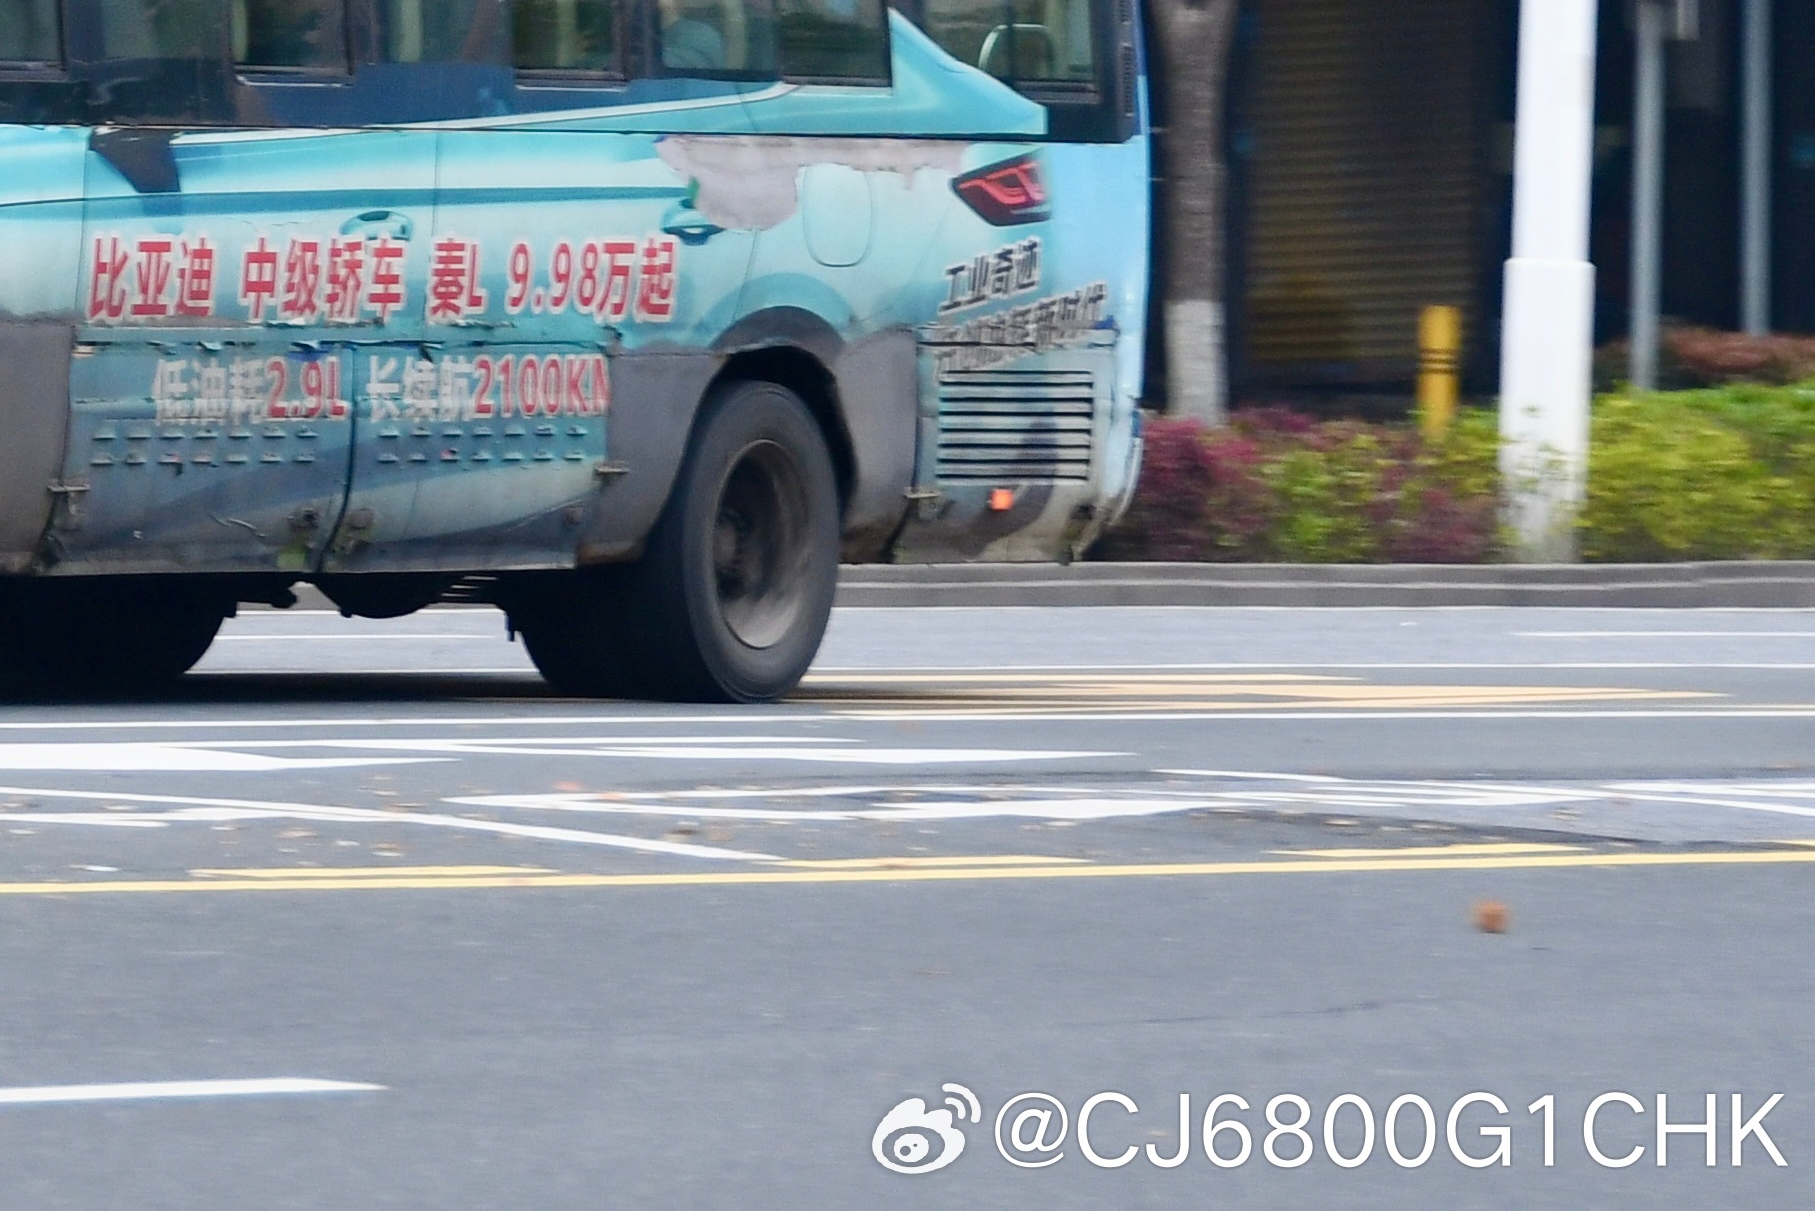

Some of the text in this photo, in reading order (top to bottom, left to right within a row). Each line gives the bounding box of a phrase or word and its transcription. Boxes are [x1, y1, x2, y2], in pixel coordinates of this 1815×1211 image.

[87, 233, 678, 322] 比亚迪 中级轿车 秦L 9.98万起
[153, 355, 348, 425] 低油耗2.9L
